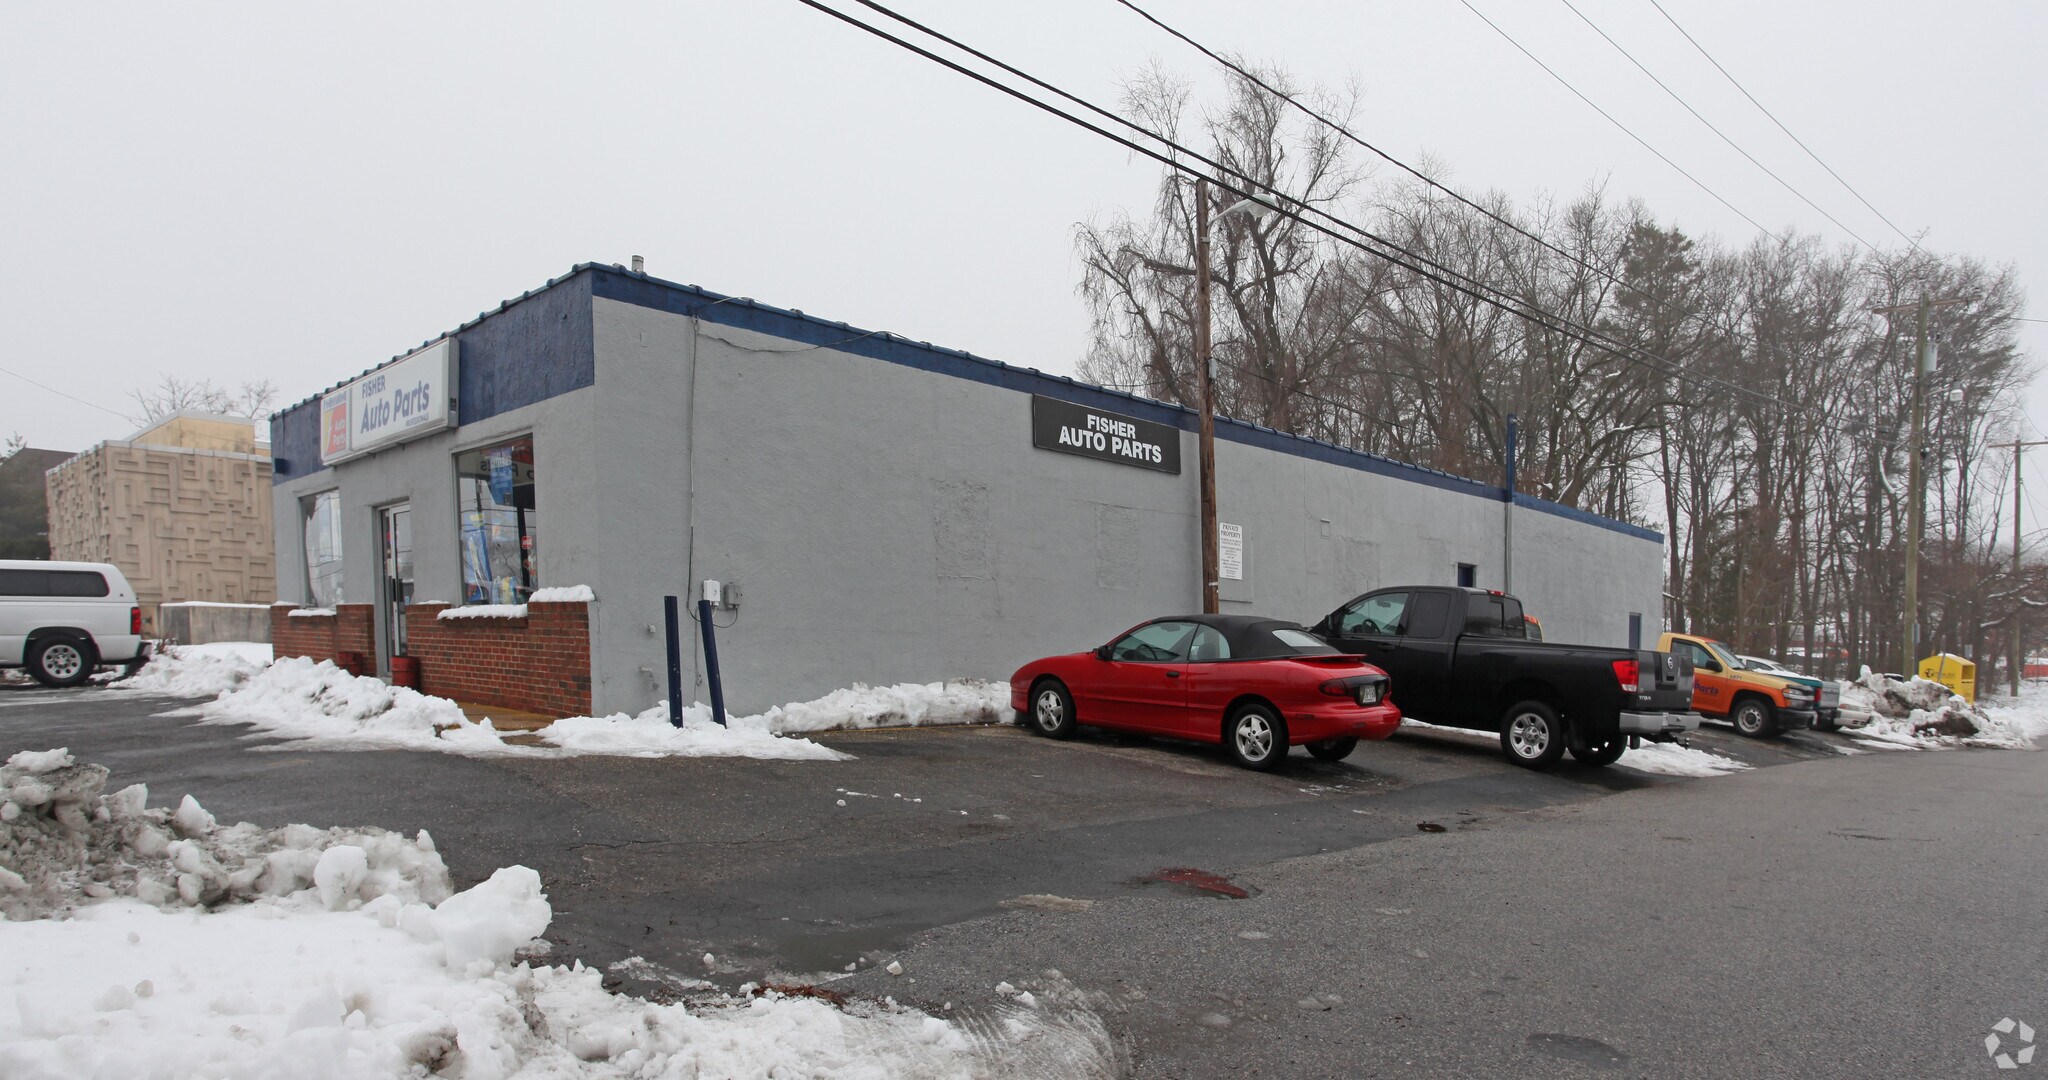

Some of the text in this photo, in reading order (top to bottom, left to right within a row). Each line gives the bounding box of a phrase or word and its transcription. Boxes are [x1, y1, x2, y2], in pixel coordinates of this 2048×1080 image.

[362, 375, 386, 399] FISHER
[360, 380, 430, 434] Auto Parts
[1087, 413, 1136, 439] FISHER
[1058, 425, 1162, 463] AUTO PARTS
